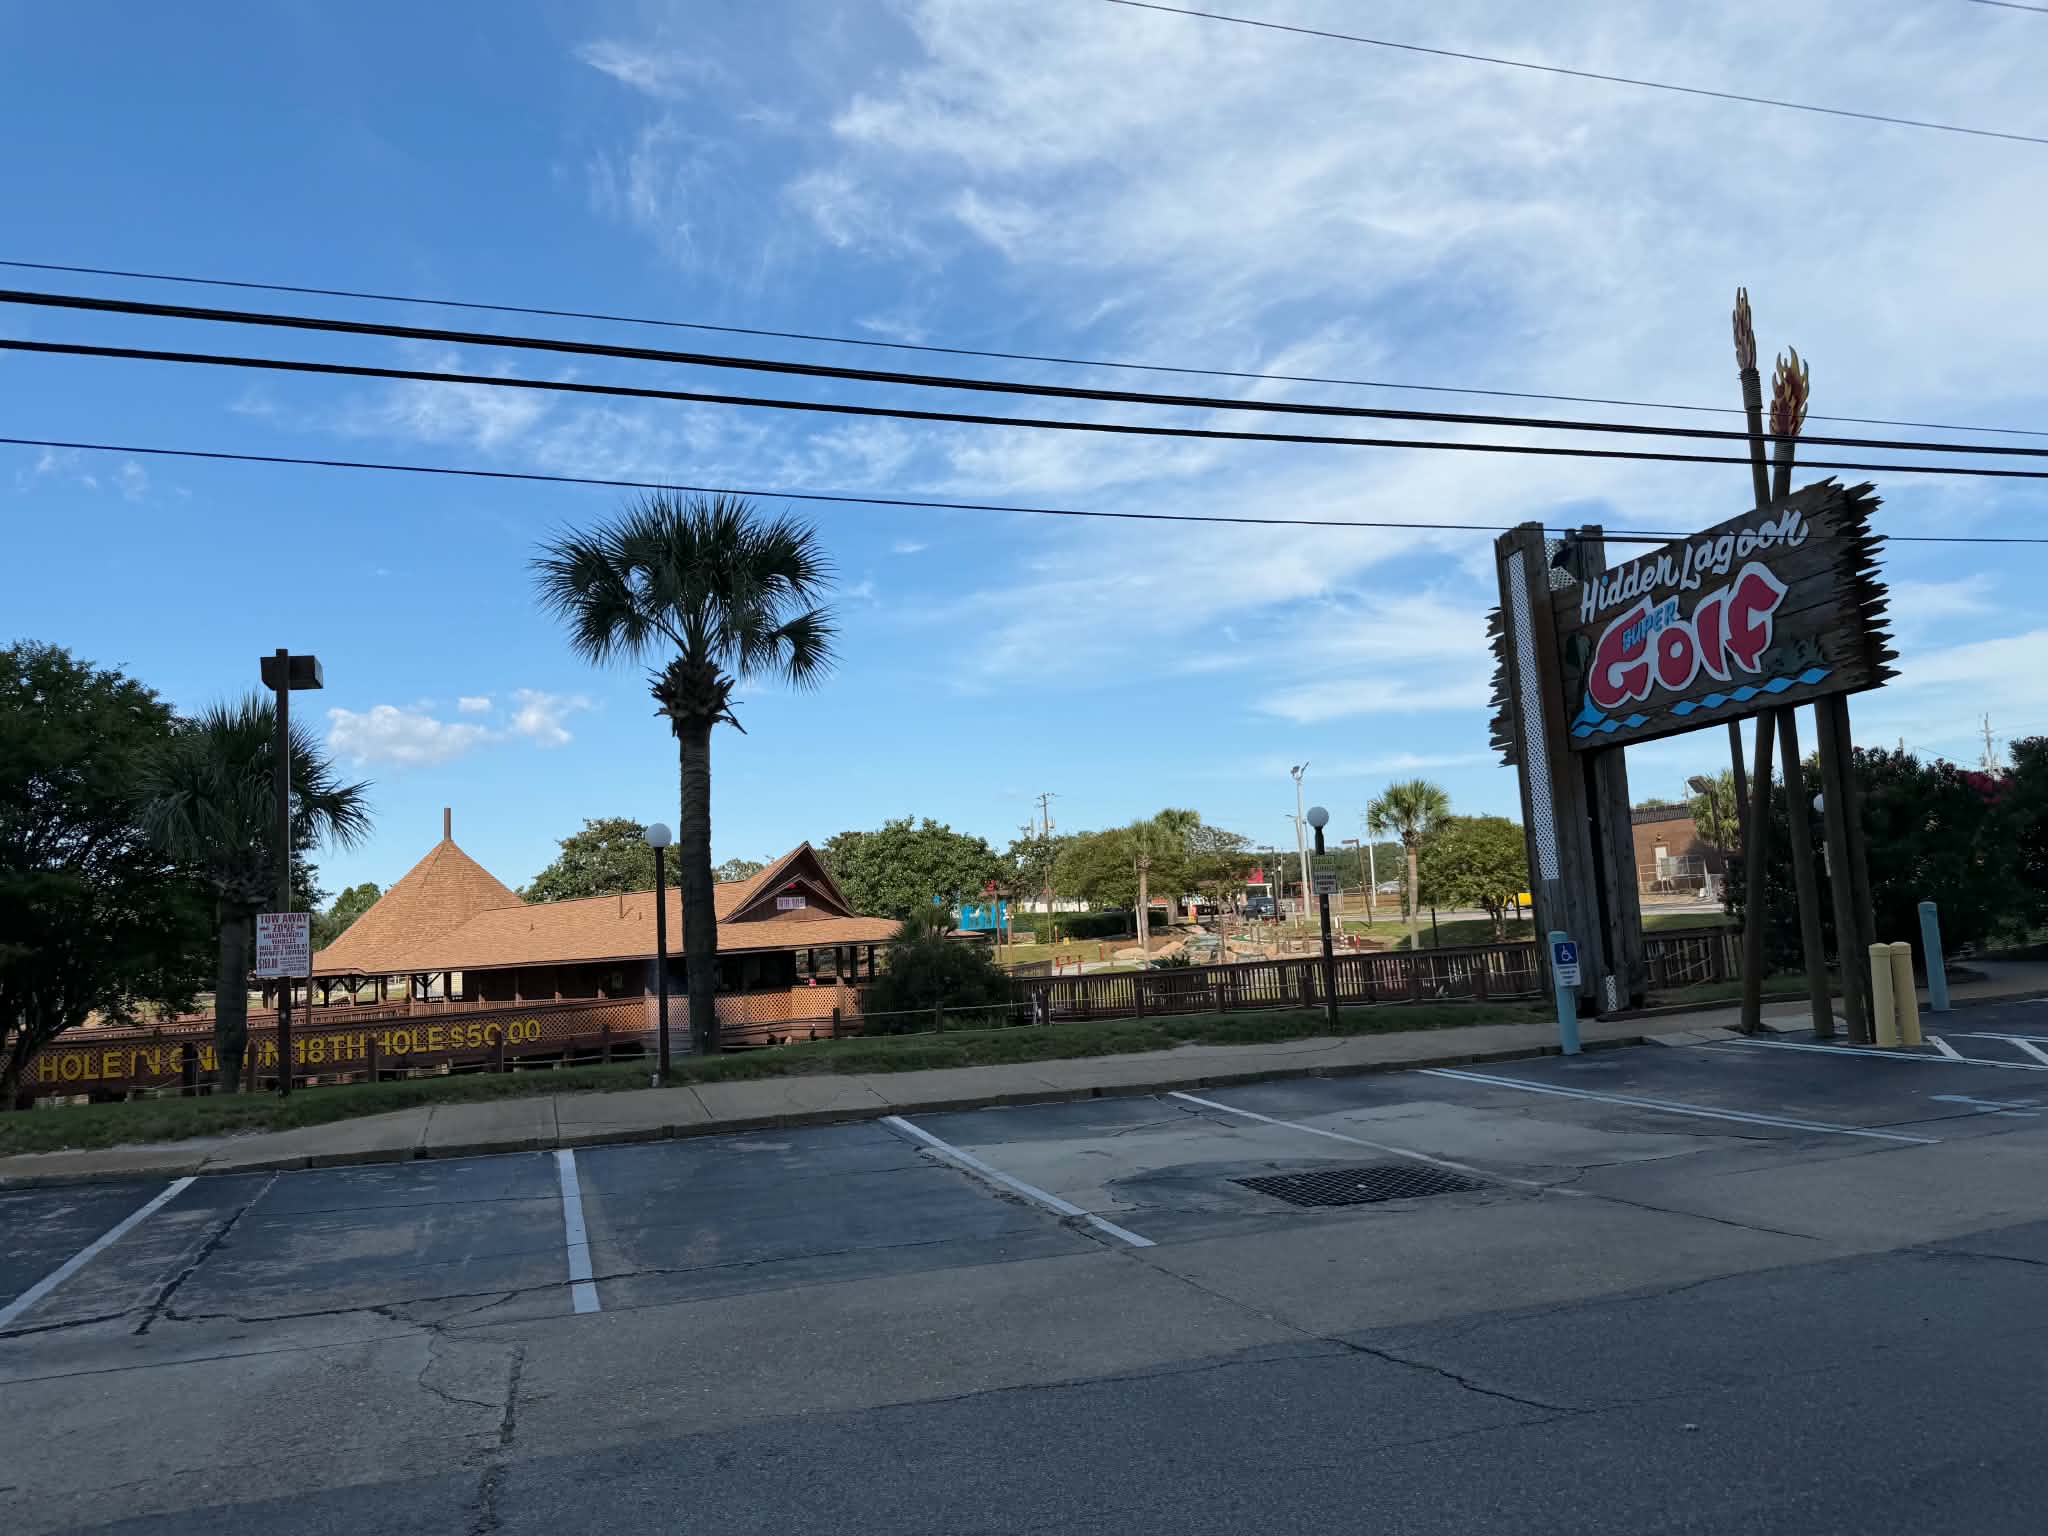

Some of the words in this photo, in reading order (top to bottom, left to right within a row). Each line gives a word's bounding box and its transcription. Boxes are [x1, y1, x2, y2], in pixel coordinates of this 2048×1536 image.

[1580, 555, 1680, 624] Hidden
[1679, 509, 1809, 590] Lagoon
[1622, 601, 1679, 654] SUPER
[260, 914, 280, 924] TOW
[282, 913, 306, 923] AWAY
[38, 1051, 123, 1082] HOLE
[294, 1033, 366, 1064] 18TH
